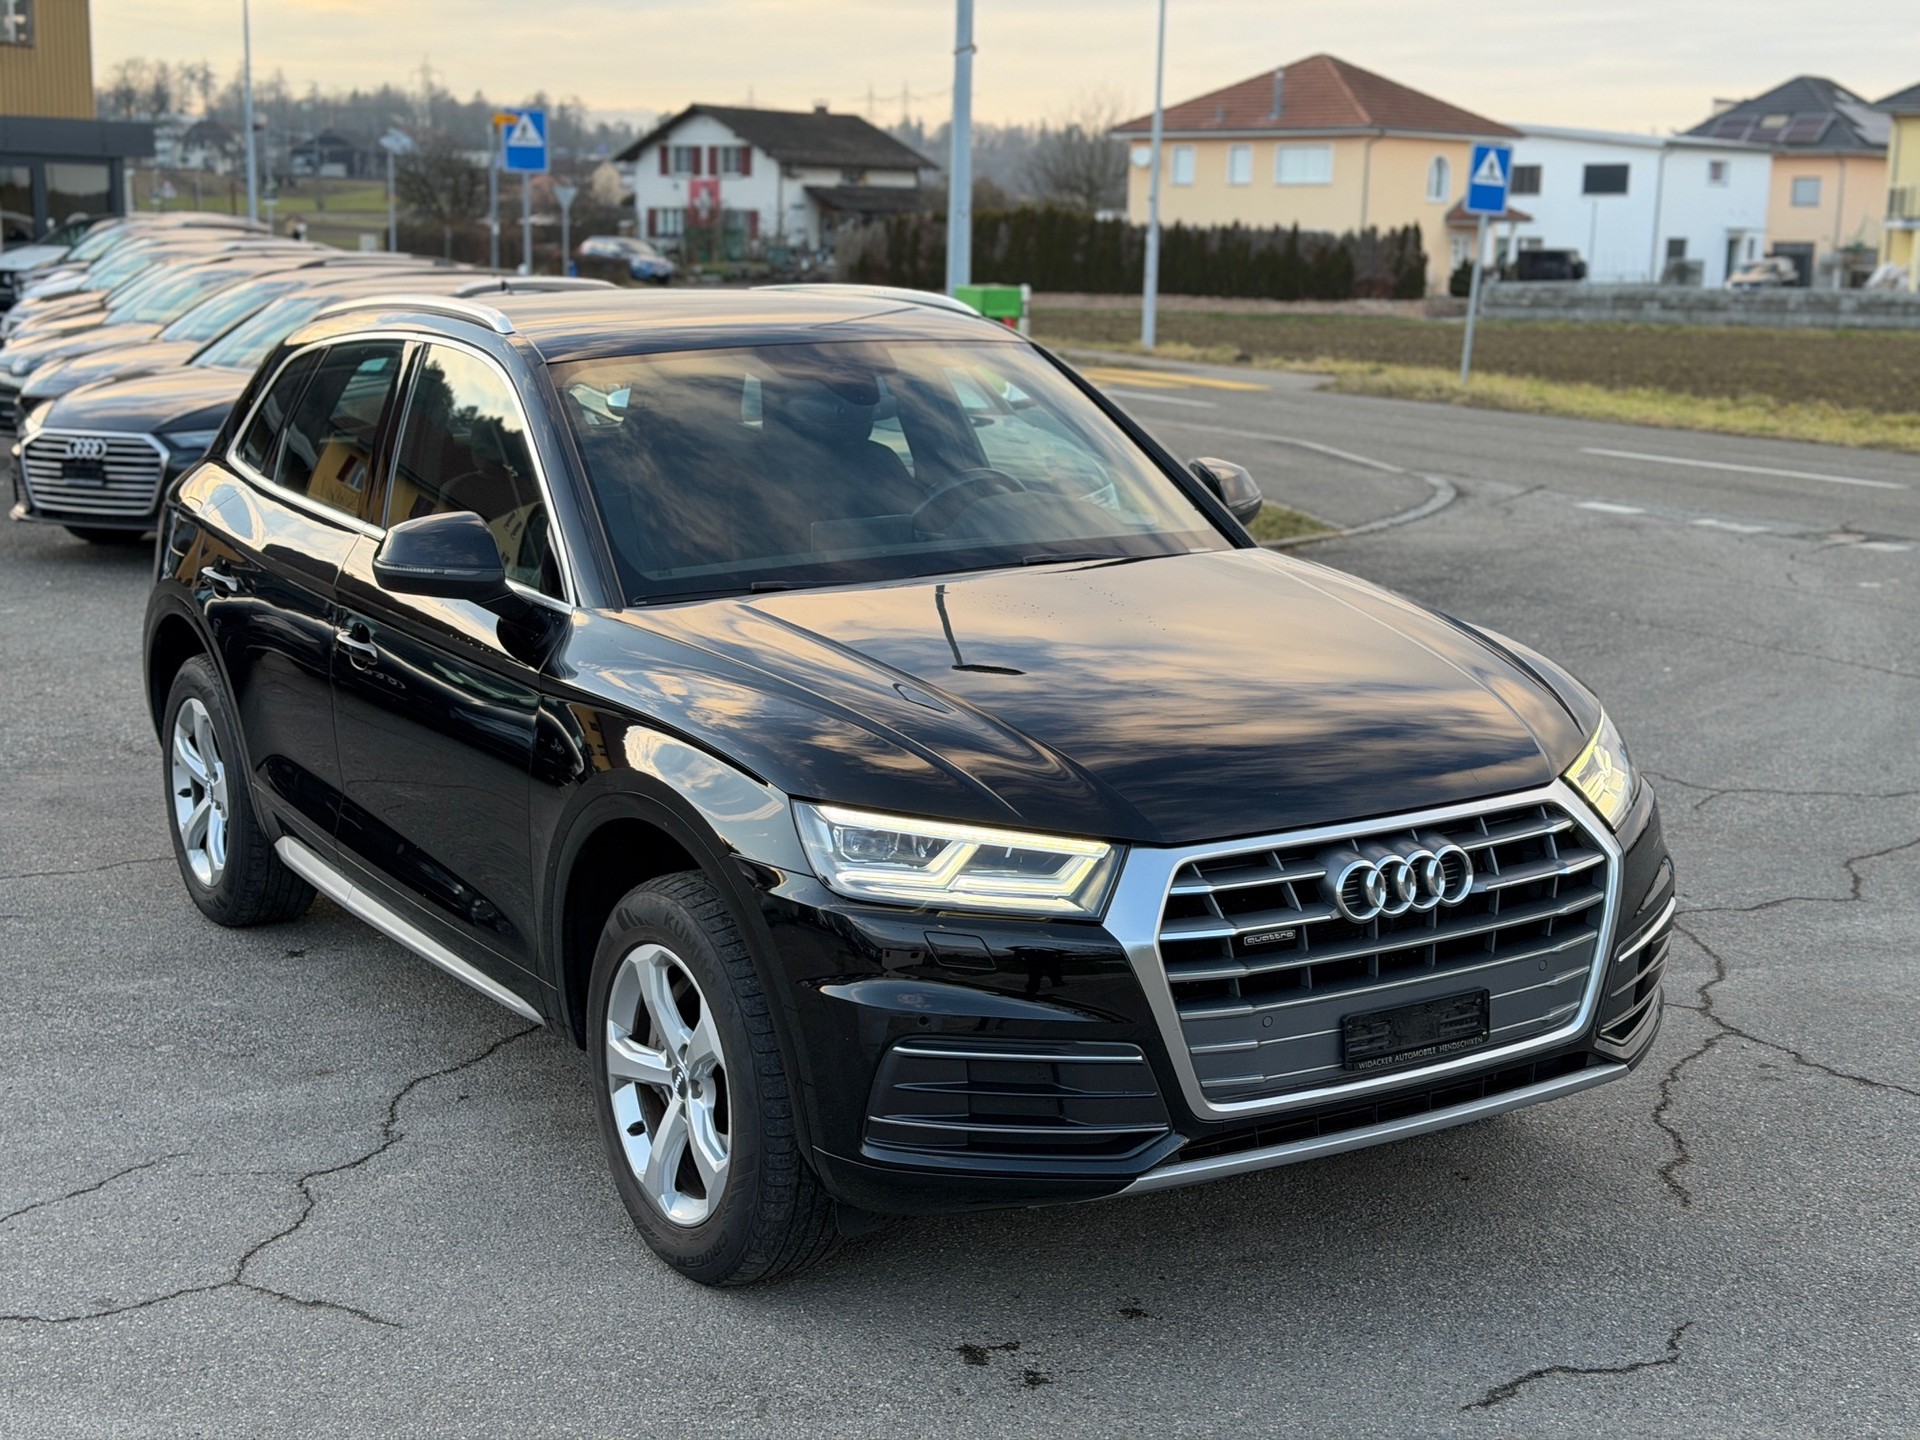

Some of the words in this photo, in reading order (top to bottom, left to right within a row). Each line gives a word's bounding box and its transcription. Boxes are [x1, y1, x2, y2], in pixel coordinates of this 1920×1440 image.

[1247, 931, 1294, 944] quattro
[1358, 1056, 1393, 1070] WIDACKER
[1395, 1046, 1437, 1063] AUTOMOBILE
